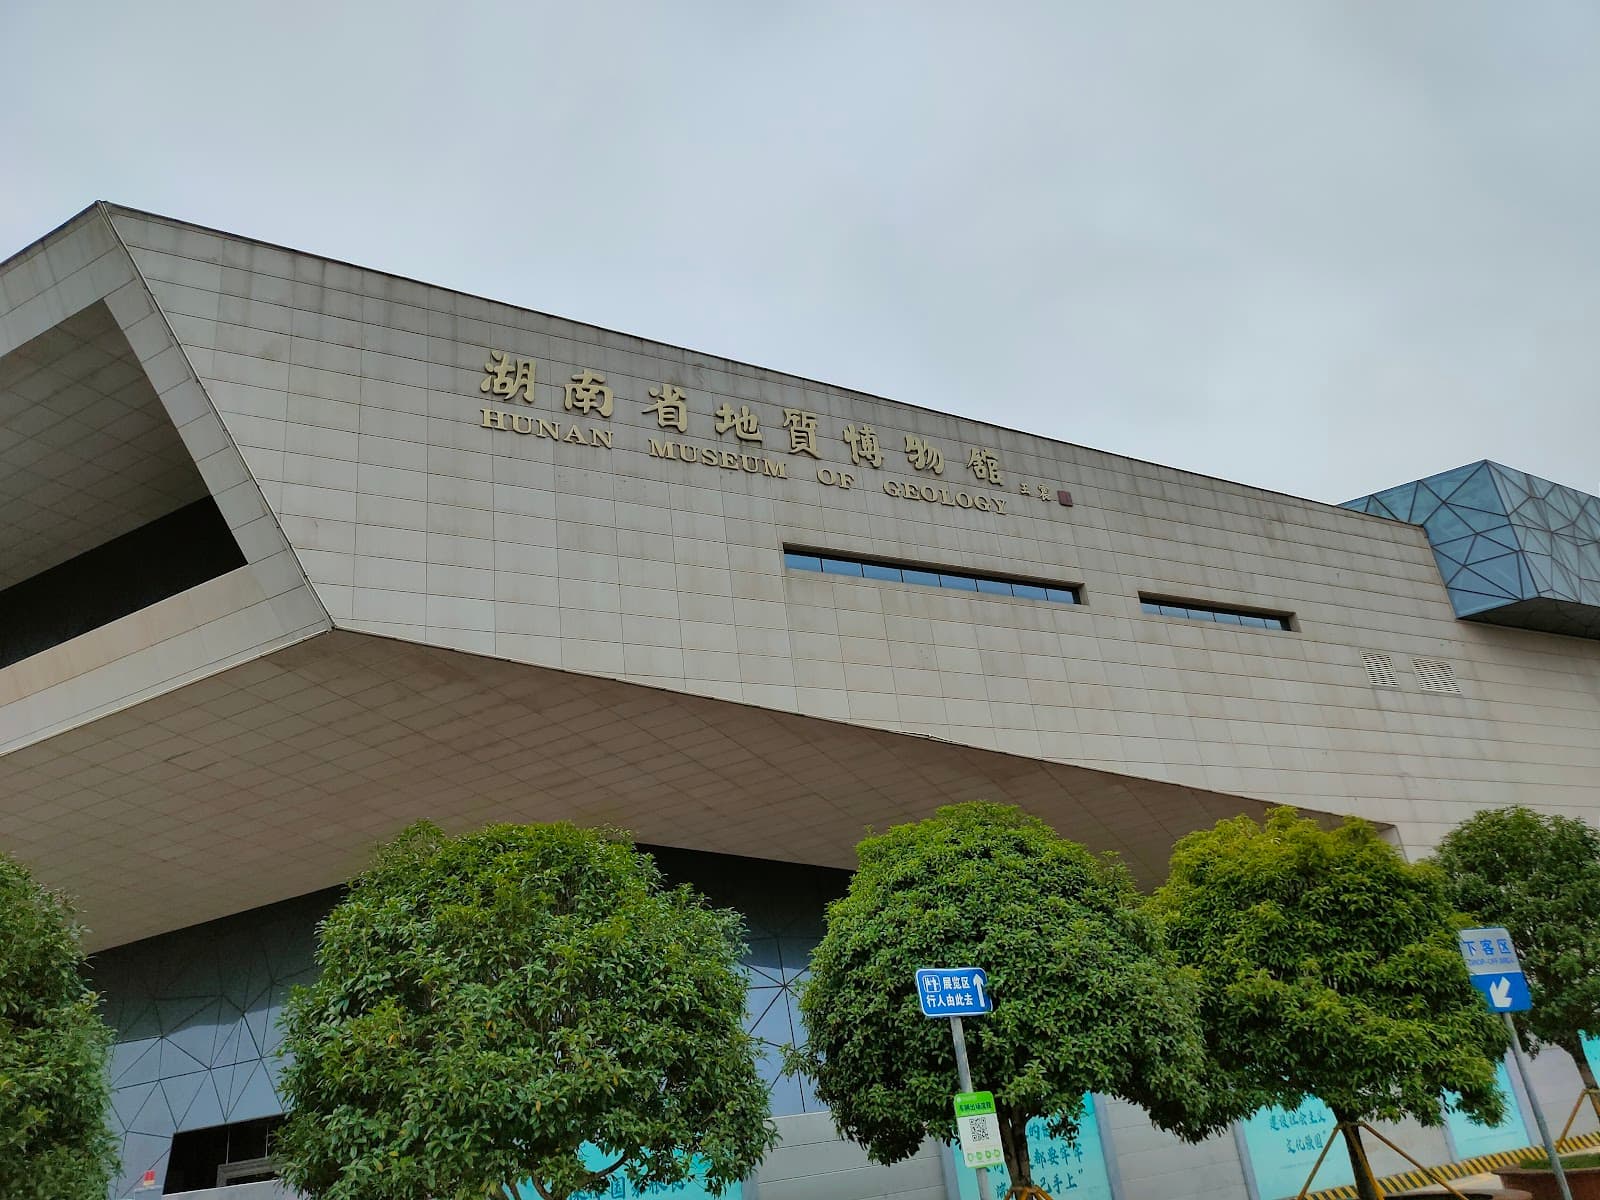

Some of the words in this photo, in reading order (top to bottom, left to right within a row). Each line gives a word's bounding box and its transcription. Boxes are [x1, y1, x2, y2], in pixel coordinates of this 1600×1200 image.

[480, 408, 614, 449] HUNAN
[648, 438, 788, 479] MUSEUM
[817, 468, 854, 489] OF
[883, 479, 1008, 515] GEOLOGY
[1463, 938, 1511, 956] 下客区
[943, 976, 971, 990] 展览区
[926, 992, 973, 1008] 行人由此去
